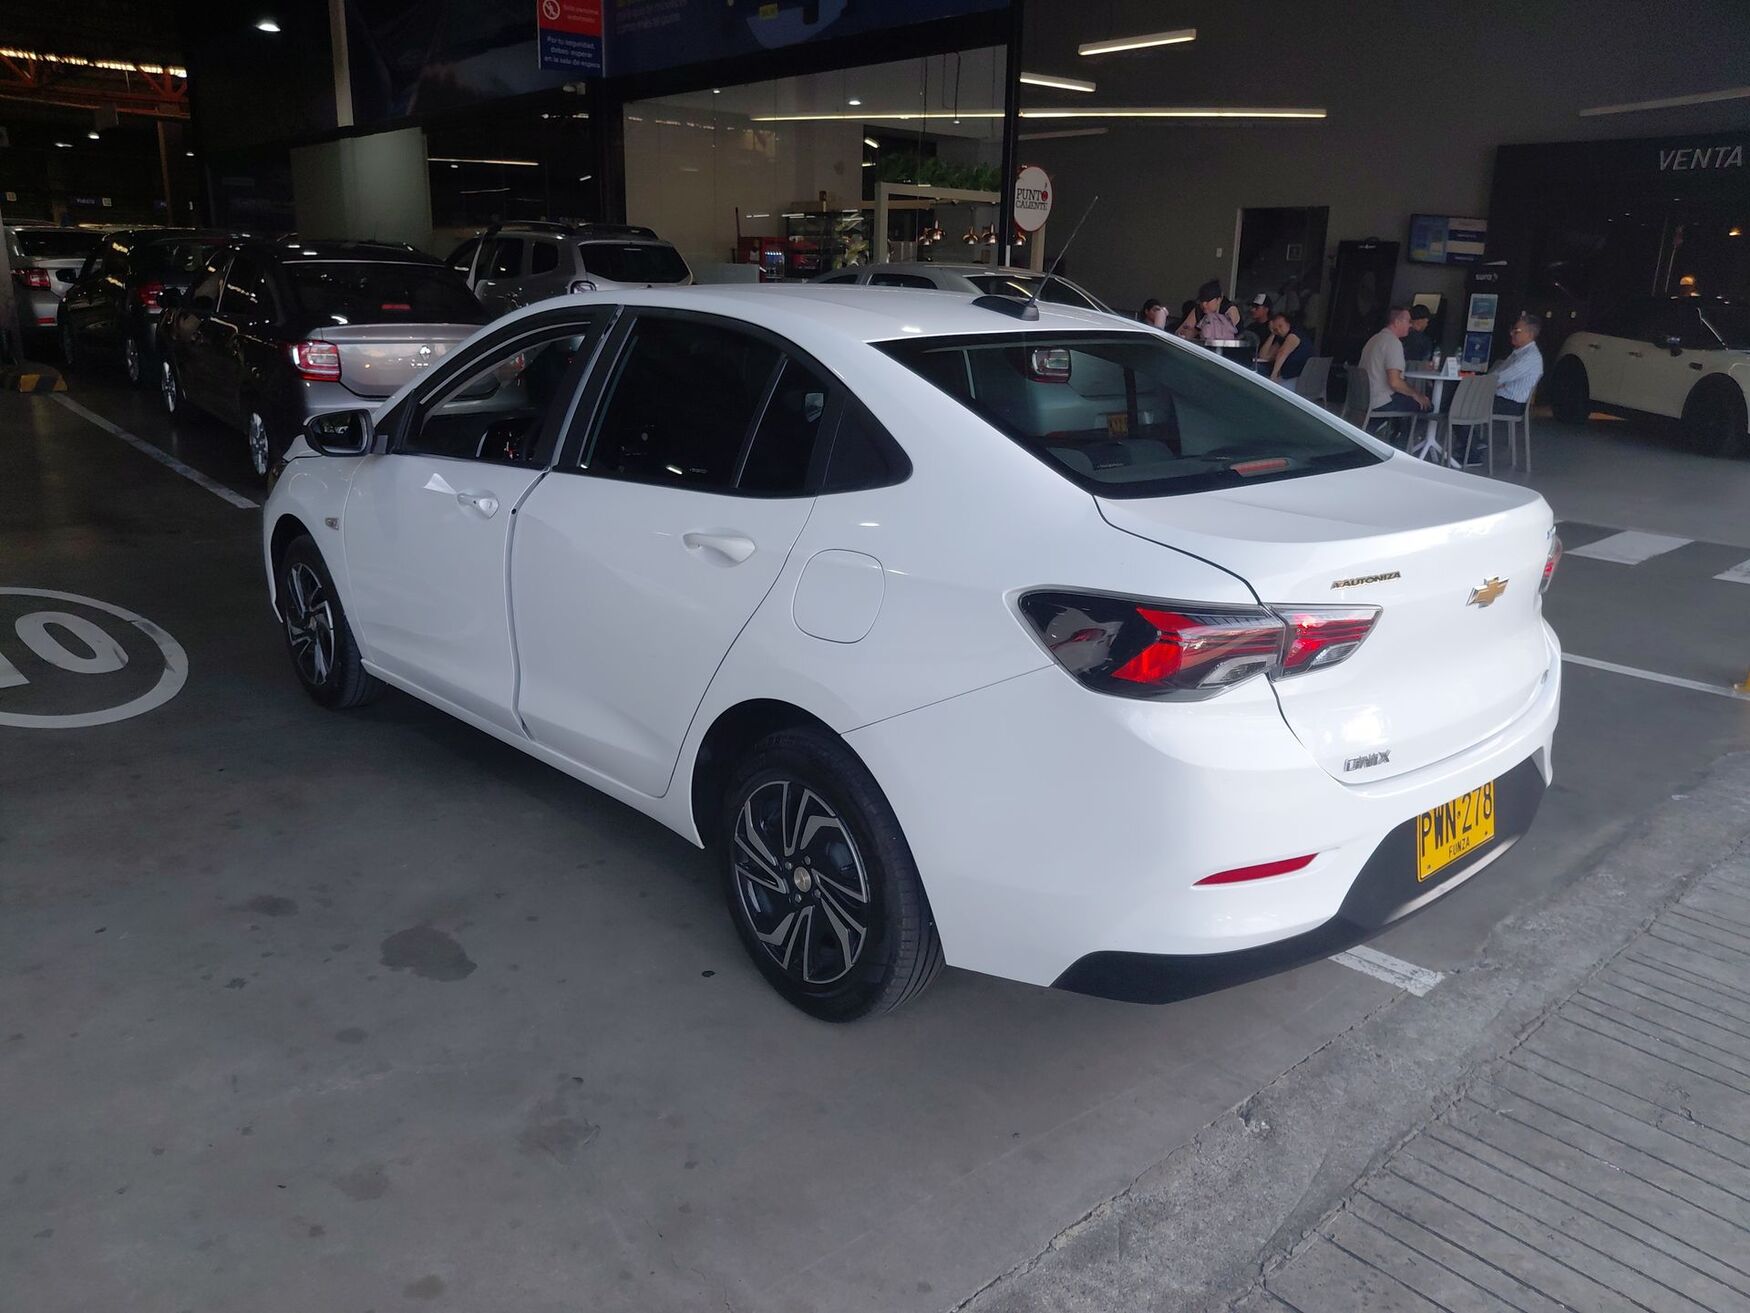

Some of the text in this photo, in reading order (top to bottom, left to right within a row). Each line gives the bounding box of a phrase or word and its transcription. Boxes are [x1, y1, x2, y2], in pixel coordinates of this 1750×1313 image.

[1659, 145, 1743, 171] VENTA
[1016, 188, 1048, 202] PUNTO
[1016, 200, 1048, 210] CALIENTE
[1342, 571, 1401, 587] AUTONIZA
[1344, 749, 1391, 772] ONIX
[1449, 837, 1470, 858] FUNZA
